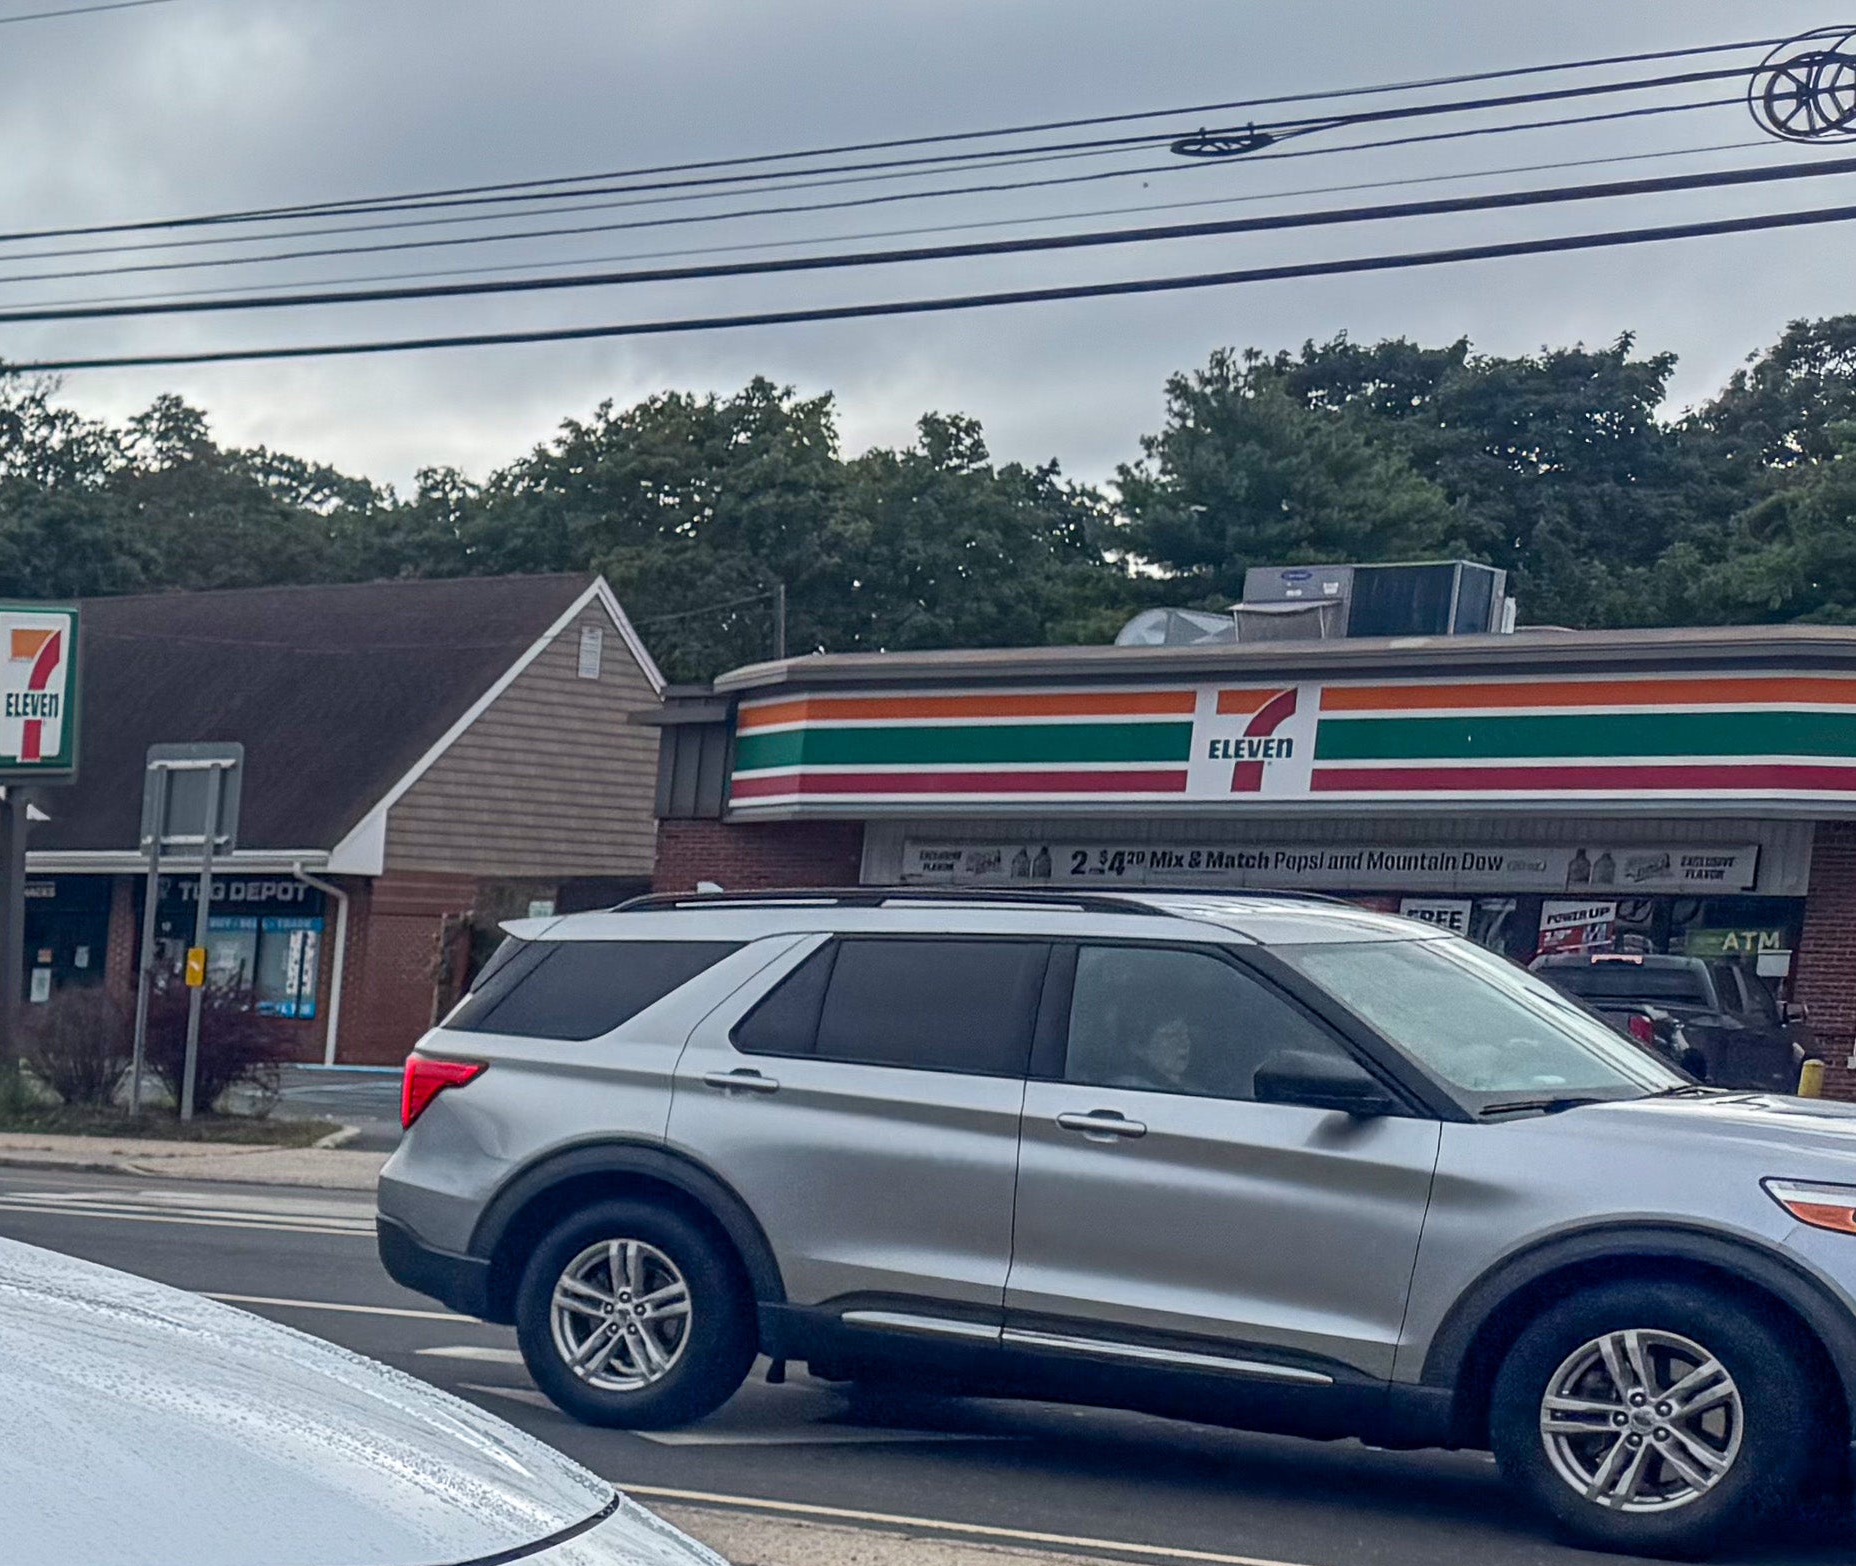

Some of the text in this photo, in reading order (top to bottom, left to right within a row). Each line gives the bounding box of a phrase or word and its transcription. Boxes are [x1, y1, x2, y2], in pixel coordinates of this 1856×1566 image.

[11, 629, 62, 761] 7
[1216, 687, 1298, 792] 7
[1150, 851, 1183, 868] Mix
[1188, 851, 1202, 868] &
[1207, 851, 1268, 869] Match
[1327, 851, 1363, 870] and
[1367, 851, 1457, 871] Mountain
[230, 882, 309, 902] DEPOT
[1547, 907, 1610, 924] POWER UP
[1722, 931, 1780, 951] ATM
